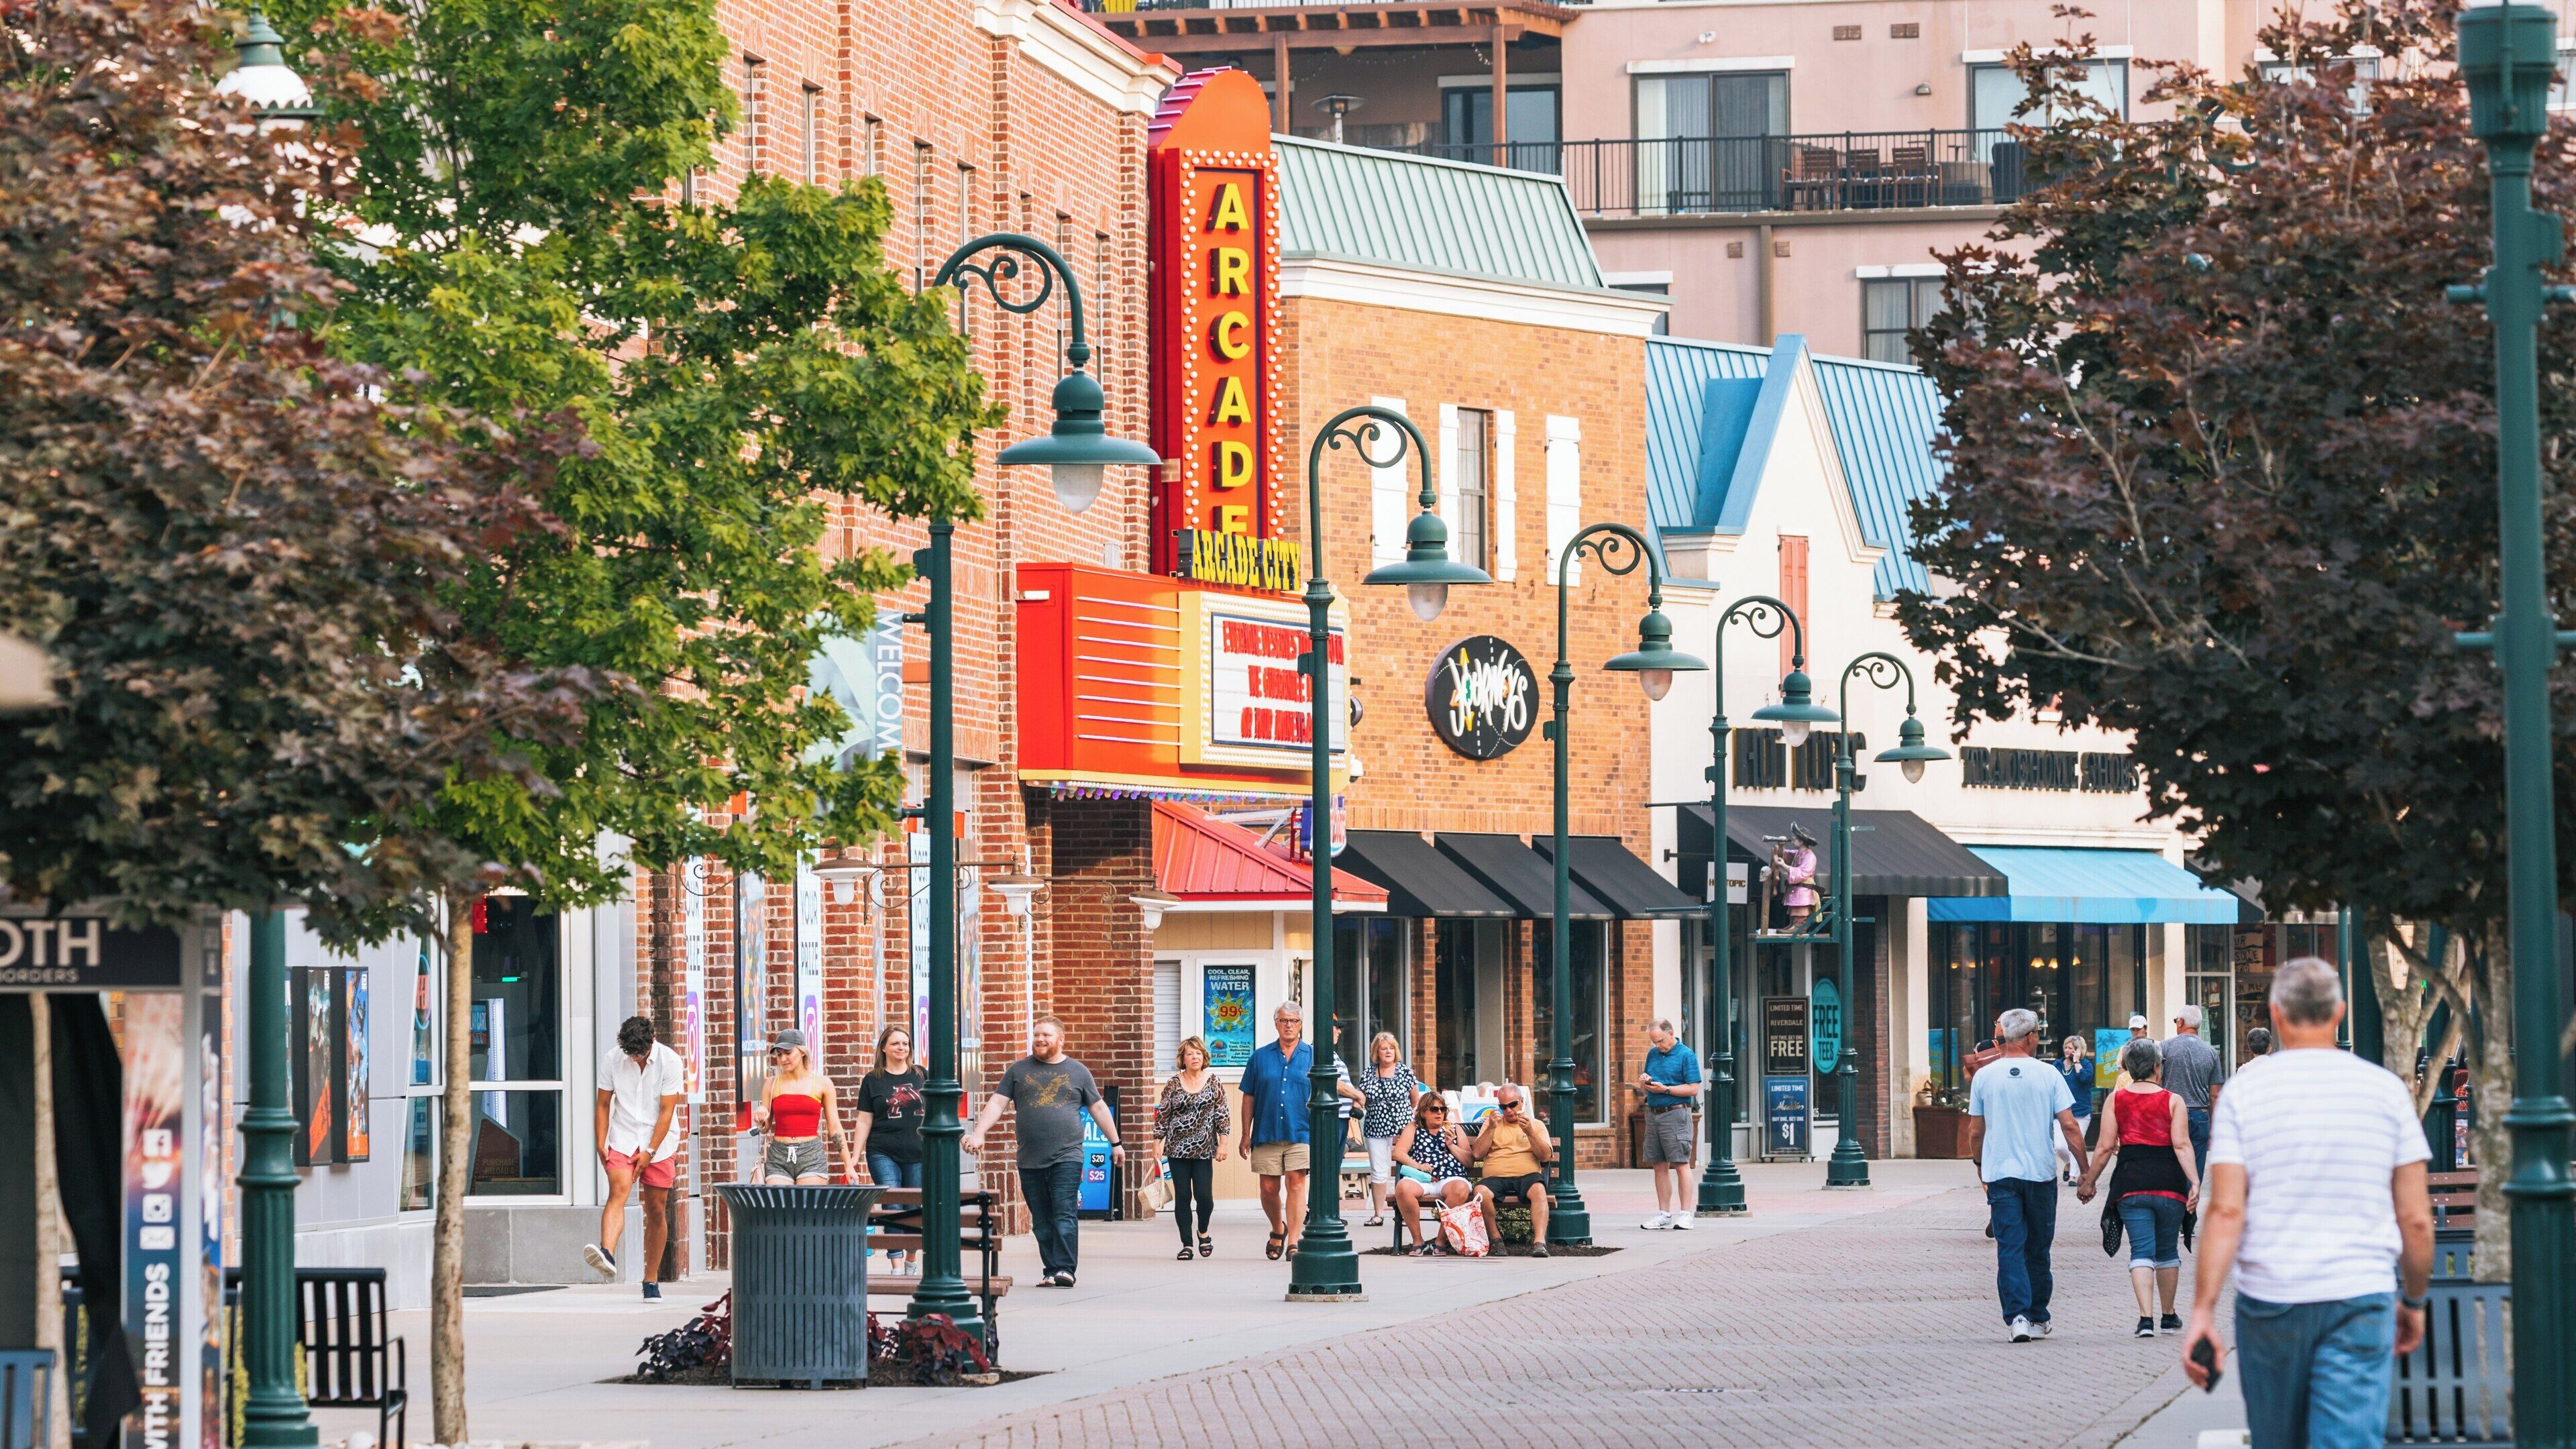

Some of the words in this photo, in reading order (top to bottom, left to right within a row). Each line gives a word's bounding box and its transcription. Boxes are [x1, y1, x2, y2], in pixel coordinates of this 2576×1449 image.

[1214, 182, 1254, 535] ARCADE
[1192, 528, 1260, 587] ARCADE
[1263, 538, 1300, 591] CITY
[876, 613, 902, 761] WELCOM
[1732, 727, 1786, 789] HOT
[1791, 730, 1867, 792] TOPC
[1960, 746, 2078, 792] TRADEHOME
[2080, 751, 2140, 794] SHOES
[686, 880, 699, 917] OUR
[800, 890, 818, 925] YOUR
[914, 898, 930, 931] YOUR
[686, 935, 701, 971] RIZE
[801, 941, 818, 975] PRIZE
[915, 945, 930, 978] PRIZE
[0, 968, 79, 983] ORDERS
[1210, 981, 1250, 991] WATER
[1220, 1005, 1244, 1017] 99¢
[1813, 1005, 1838, 1038] FREE
[1770, 1040, 1804, 1057] FREE
[1818, 1041, 1834, 1061] TEES
[1772, 1100, 1805, 1111] Aladdin
[1782, 1122, 1794, 1145] $1
[1089, 1170, 1105, 1181] $25
[1091, 1155, 1104, 1163] $20
[145, 1263, 170, 1387] FRIENDS
